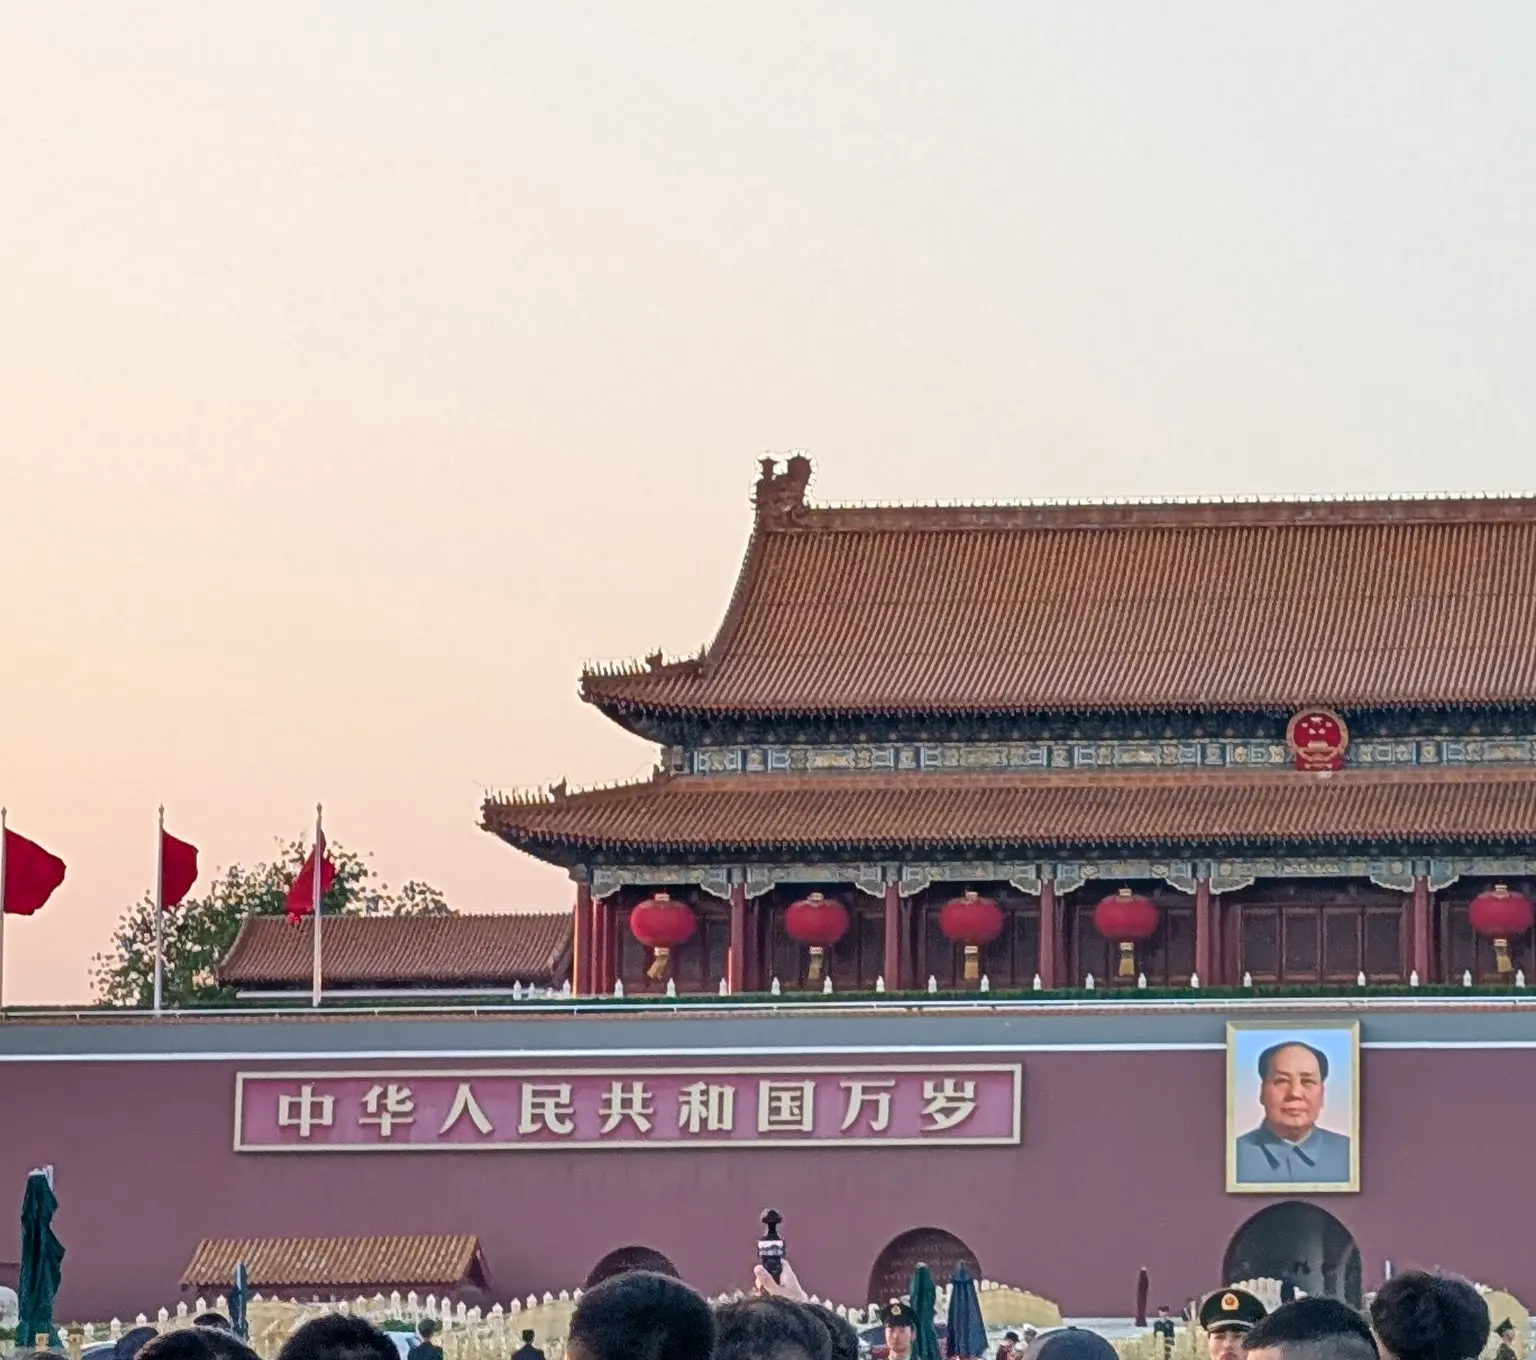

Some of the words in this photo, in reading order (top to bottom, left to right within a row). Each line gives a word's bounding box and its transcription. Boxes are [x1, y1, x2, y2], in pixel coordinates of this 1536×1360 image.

[278, 1078, 977, 1137] 中华人民共和国万岁
